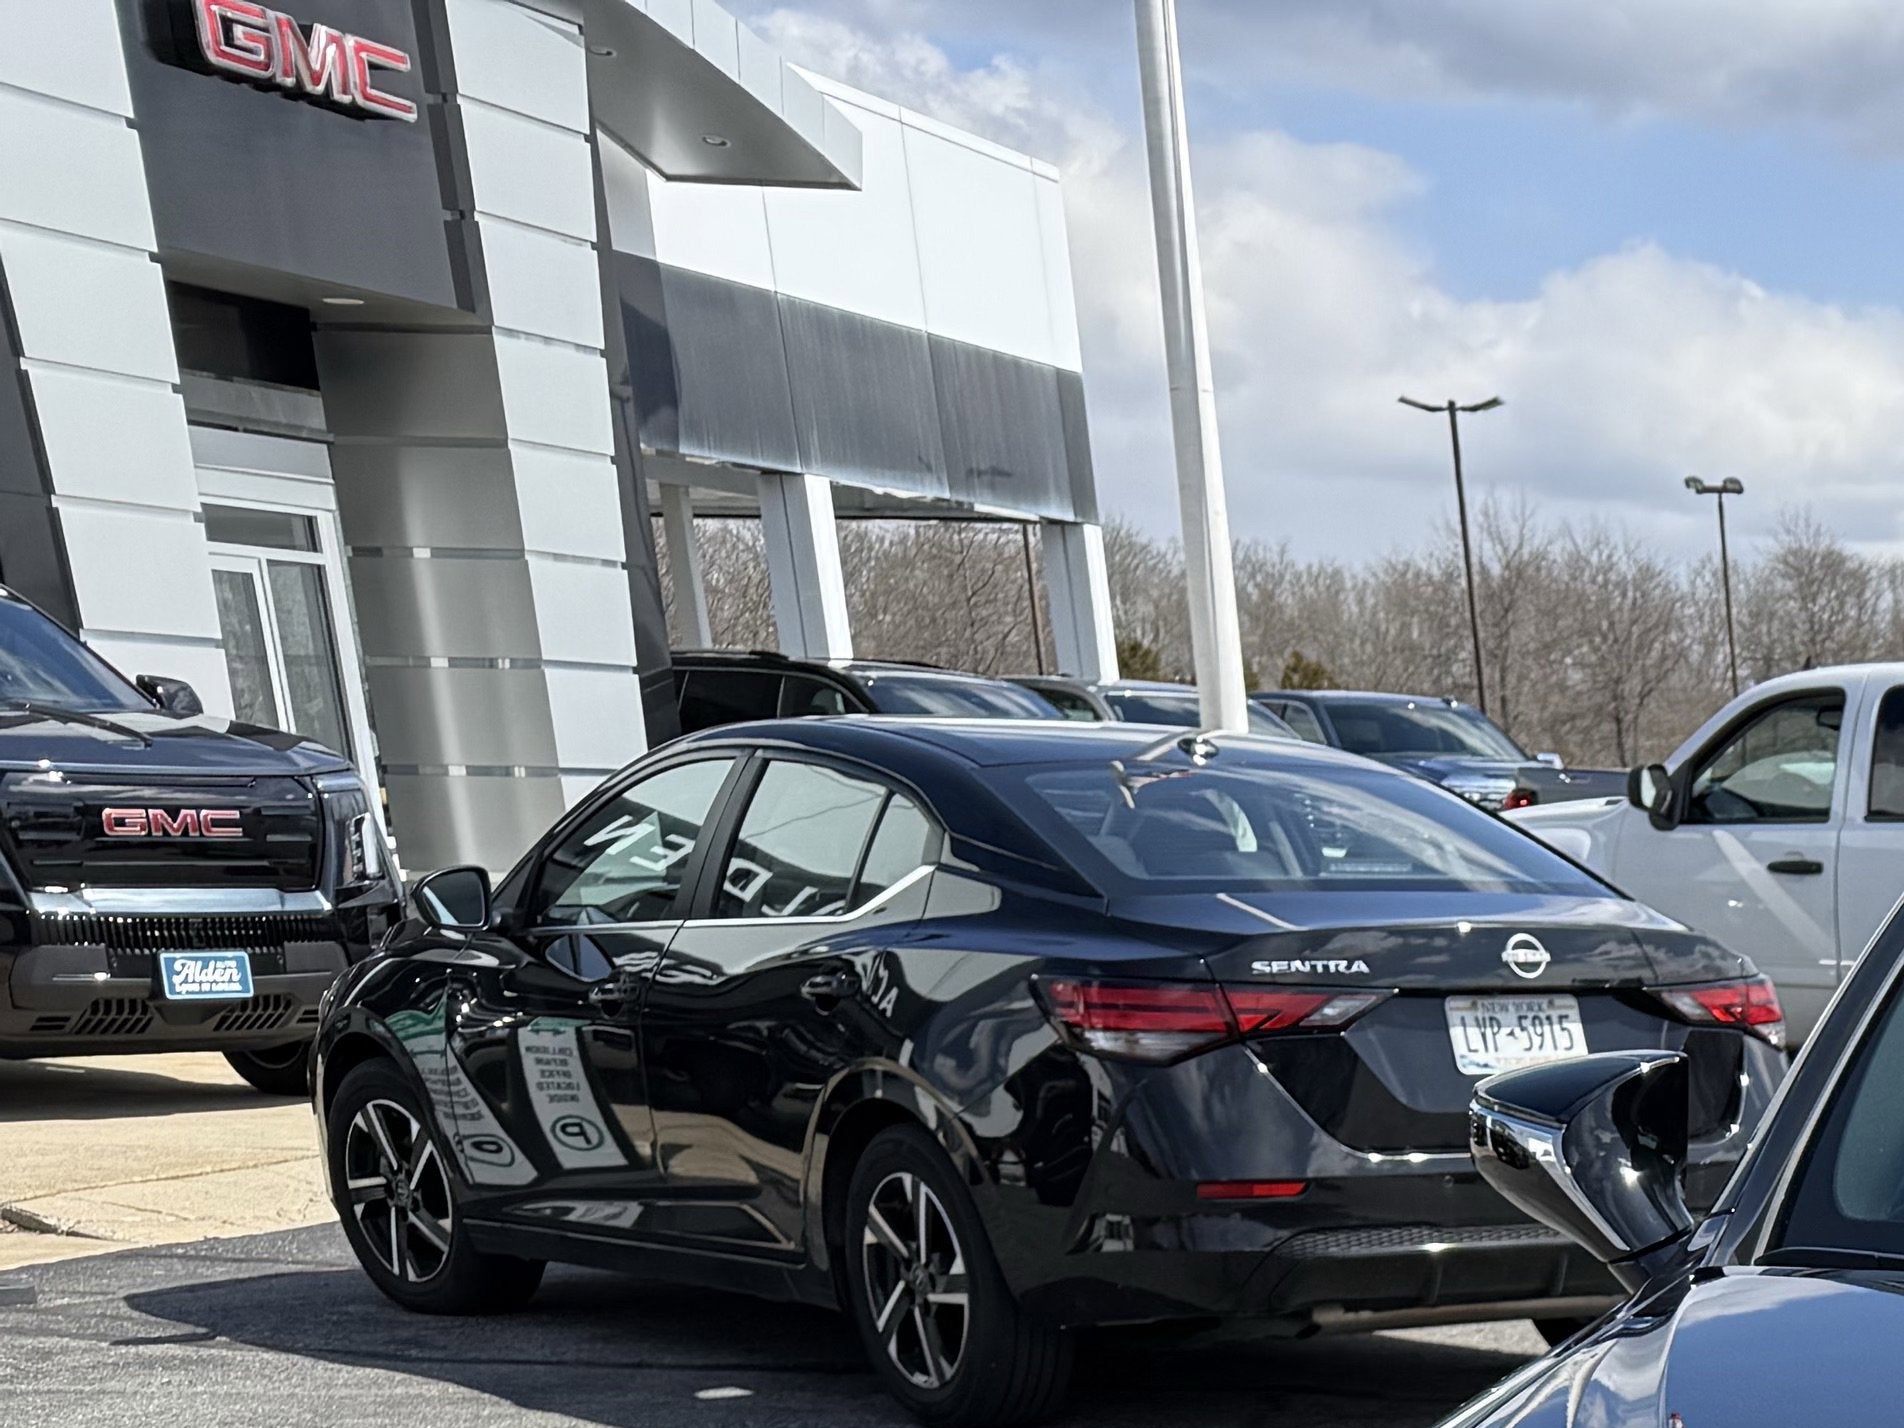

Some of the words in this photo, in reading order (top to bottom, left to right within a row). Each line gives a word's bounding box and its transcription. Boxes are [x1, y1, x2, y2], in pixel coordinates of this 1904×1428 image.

[195, 0, 417, 123] GMC
[102, 808, 243, 836] GMC
[172, 959, 241, 983] Alden
[1250, 959, 1371, 975] SENTRA
